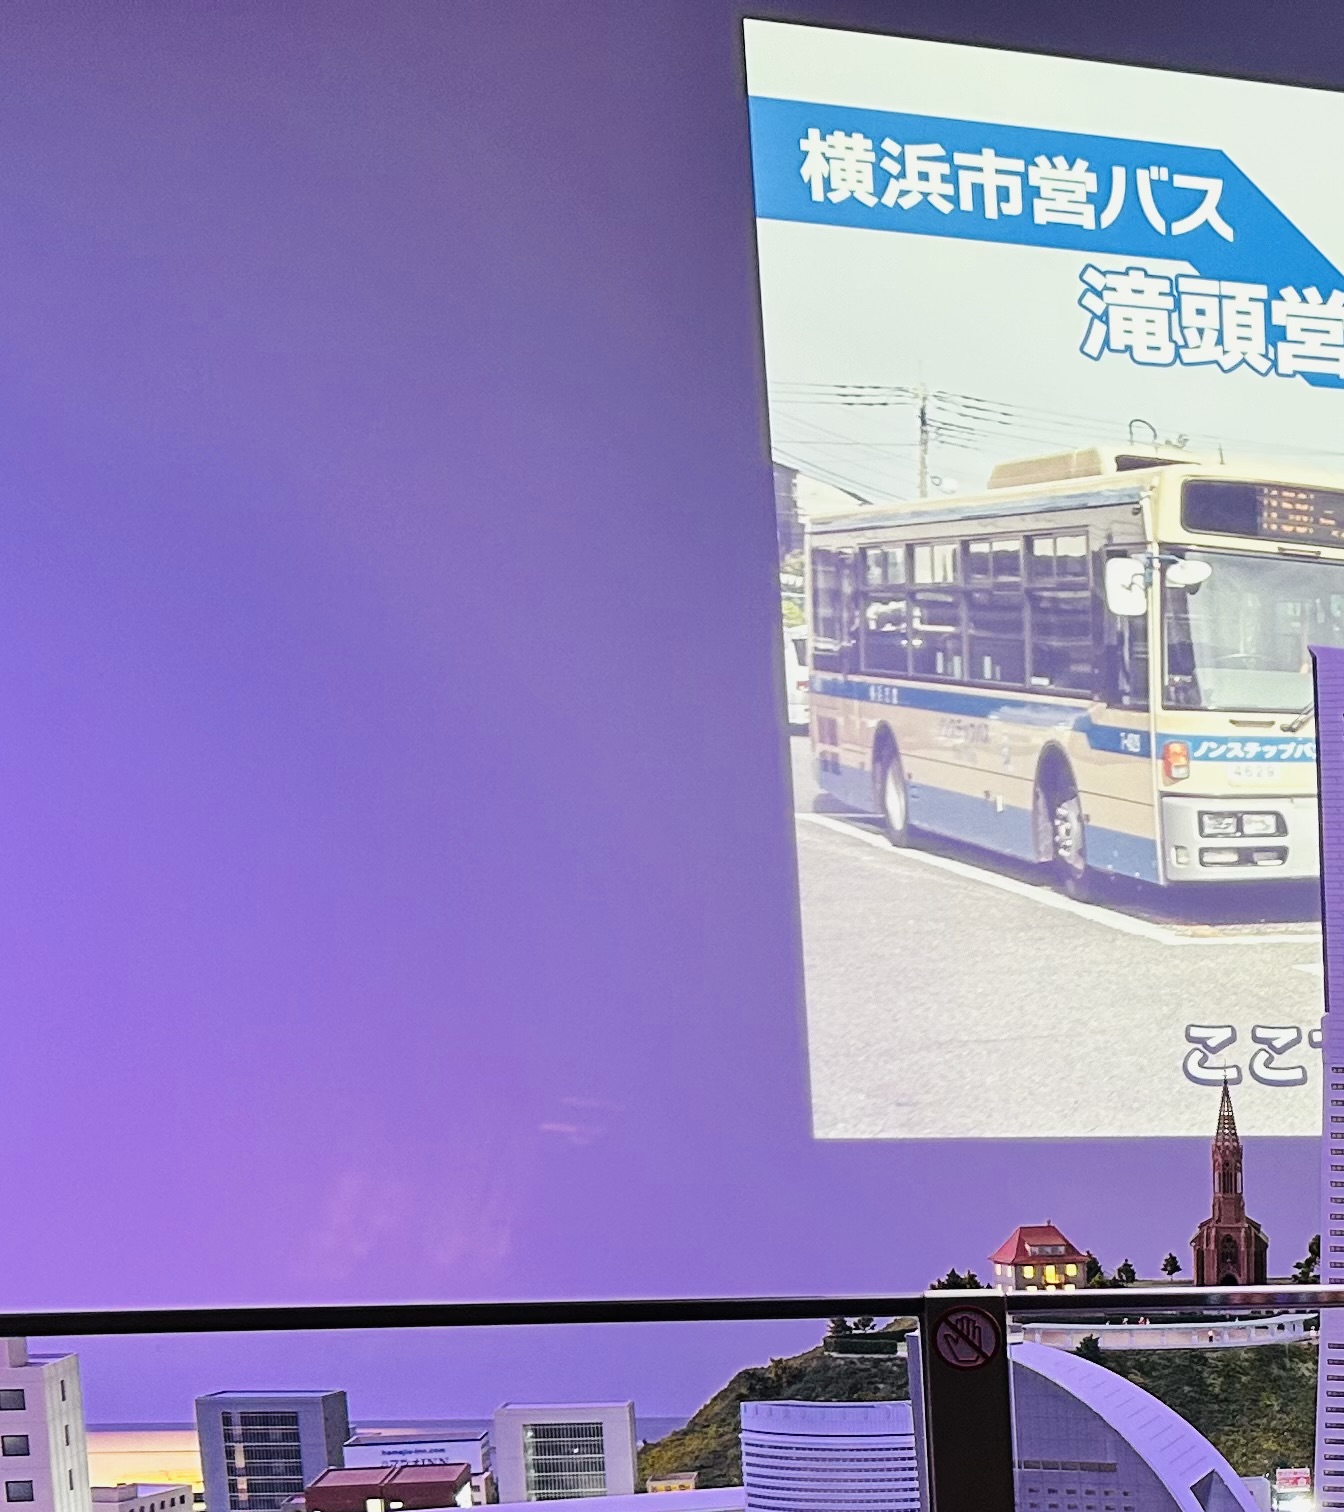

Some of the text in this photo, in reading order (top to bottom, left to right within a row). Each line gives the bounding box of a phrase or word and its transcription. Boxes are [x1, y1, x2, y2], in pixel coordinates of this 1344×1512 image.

[800, 128, 1235, 242] 横浜市営バス
[1193, 738, 1317, 759] ノンステップバ
[1183, 1024, 1323, 1087] ここ
